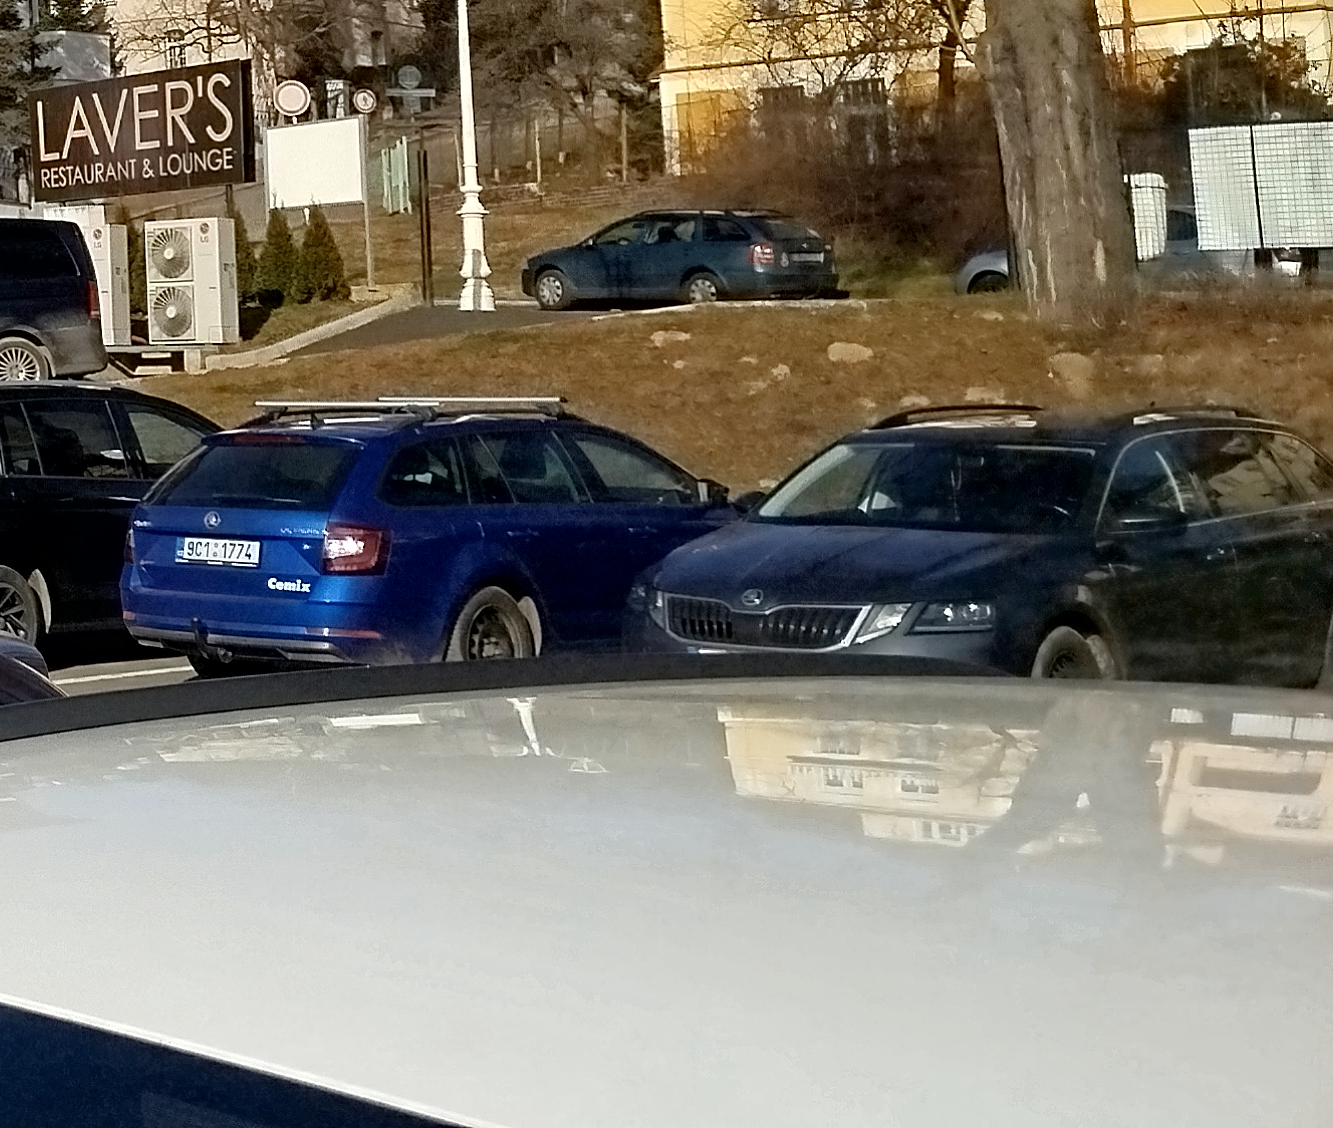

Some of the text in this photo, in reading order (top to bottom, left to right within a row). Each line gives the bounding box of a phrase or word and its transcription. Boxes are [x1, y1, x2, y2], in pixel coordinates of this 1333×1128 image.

[36, 72, 234, 163] LAVER'S
[41, 147, 234, 189] RESTAURANT & LOUNGE
[187, 541, 252, 560] 9C1 1774
[267, 577, 312, 593] Cemix
